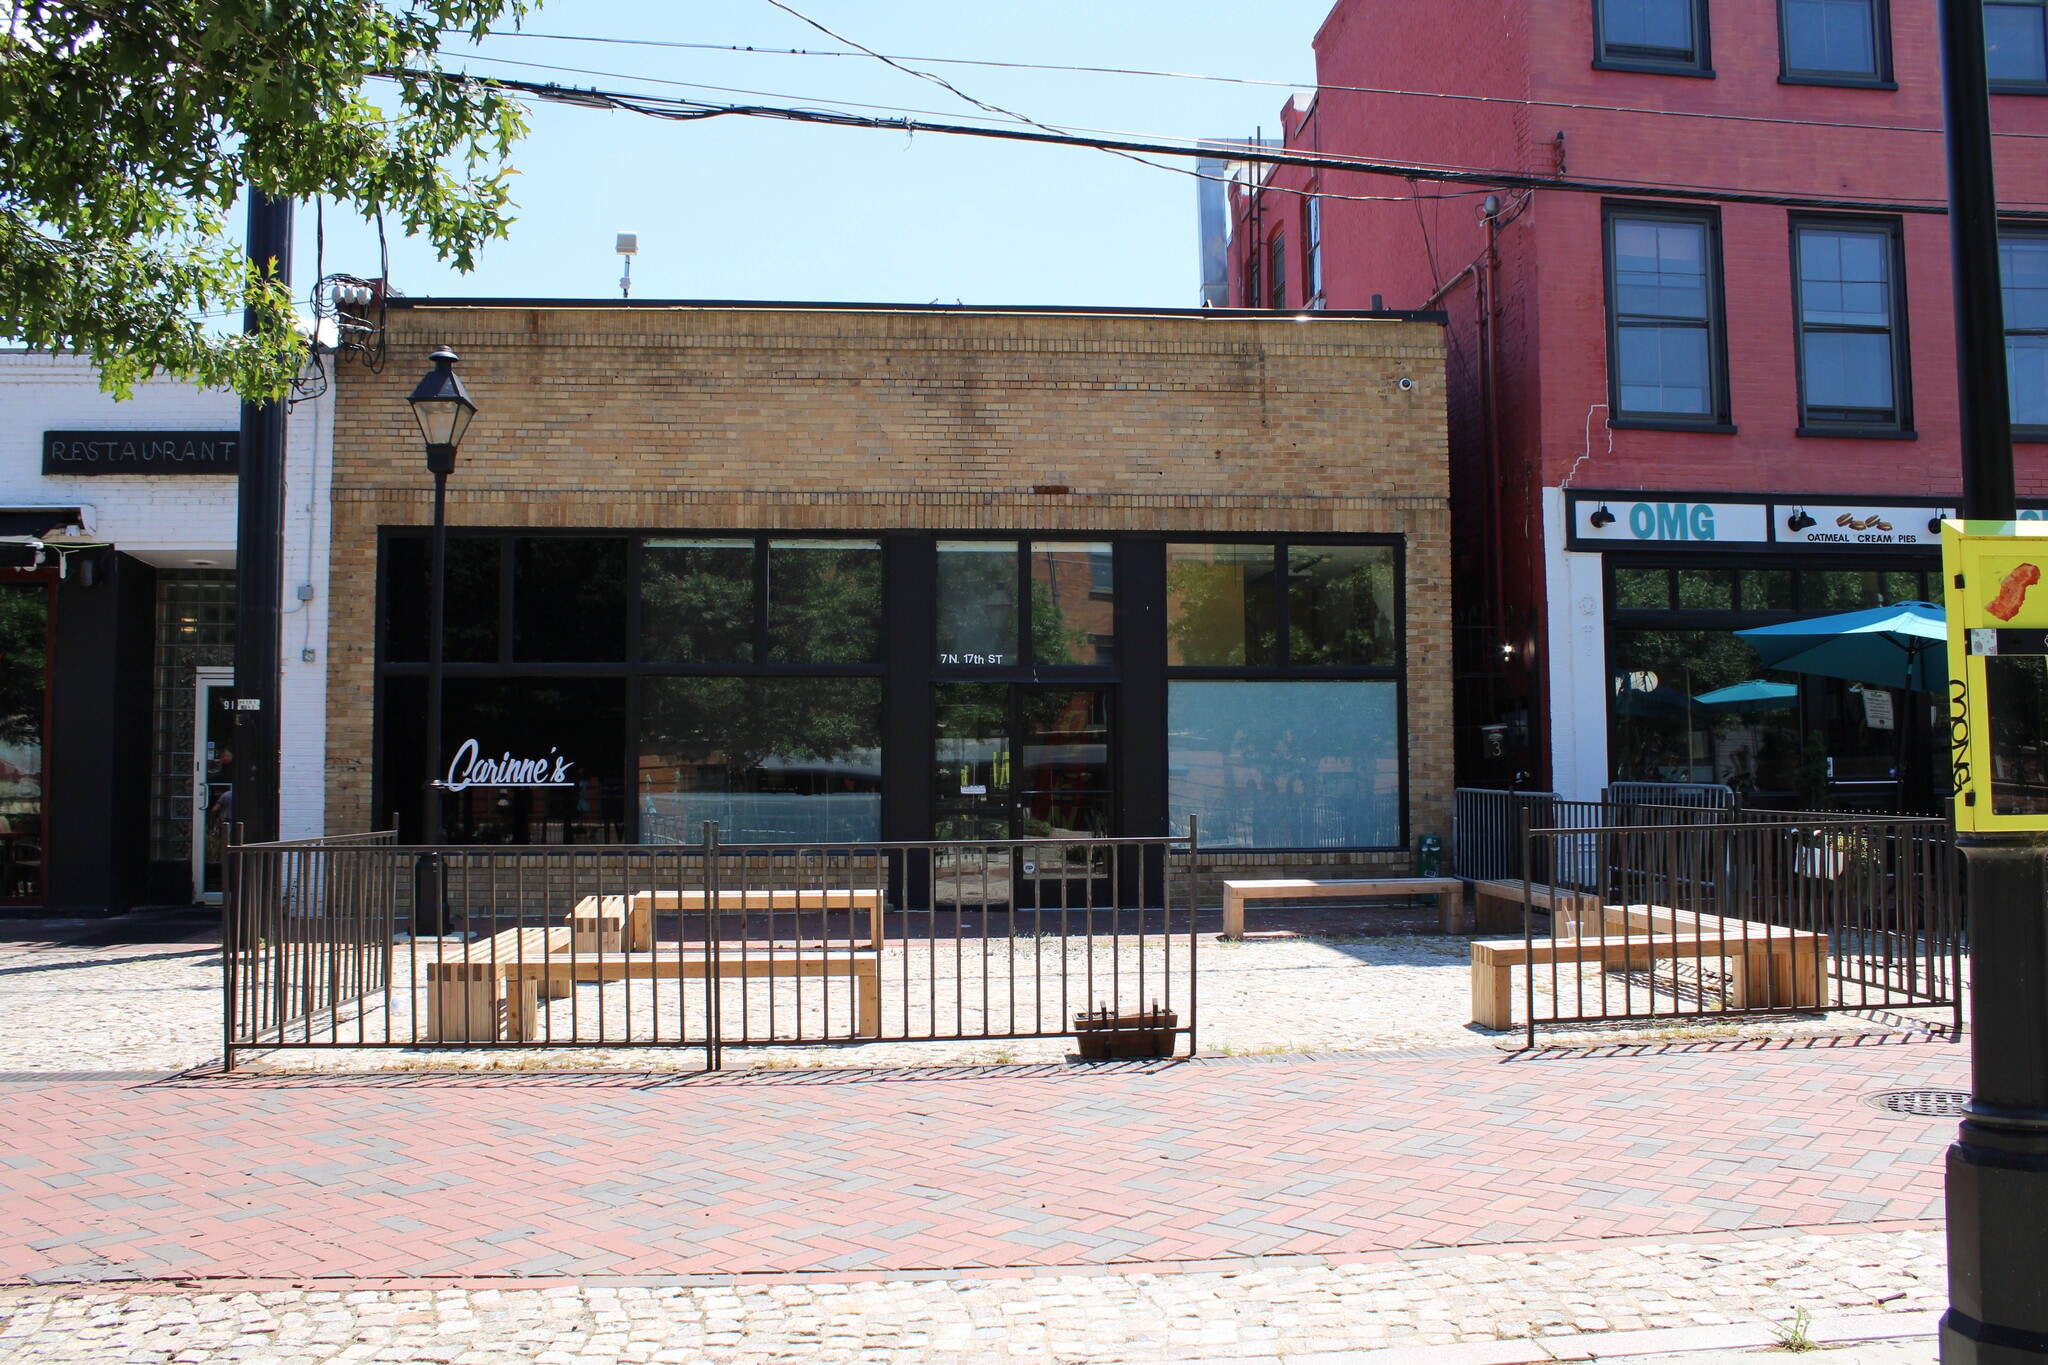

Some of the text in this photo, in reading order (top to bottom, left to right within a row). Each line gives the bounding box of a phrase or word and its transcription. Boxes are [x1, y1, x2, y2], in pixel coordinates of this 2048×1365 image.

[51, 441, 236, 462] RESTAURANT
[1629, 502, 1715, 541] OMG
[1807, 533, 1917, 543] OATMEAL CREAM PIES
[940, 653, 1003, 665] 7 N. 17th ST
[1492, 741, 1502, 757] 3
